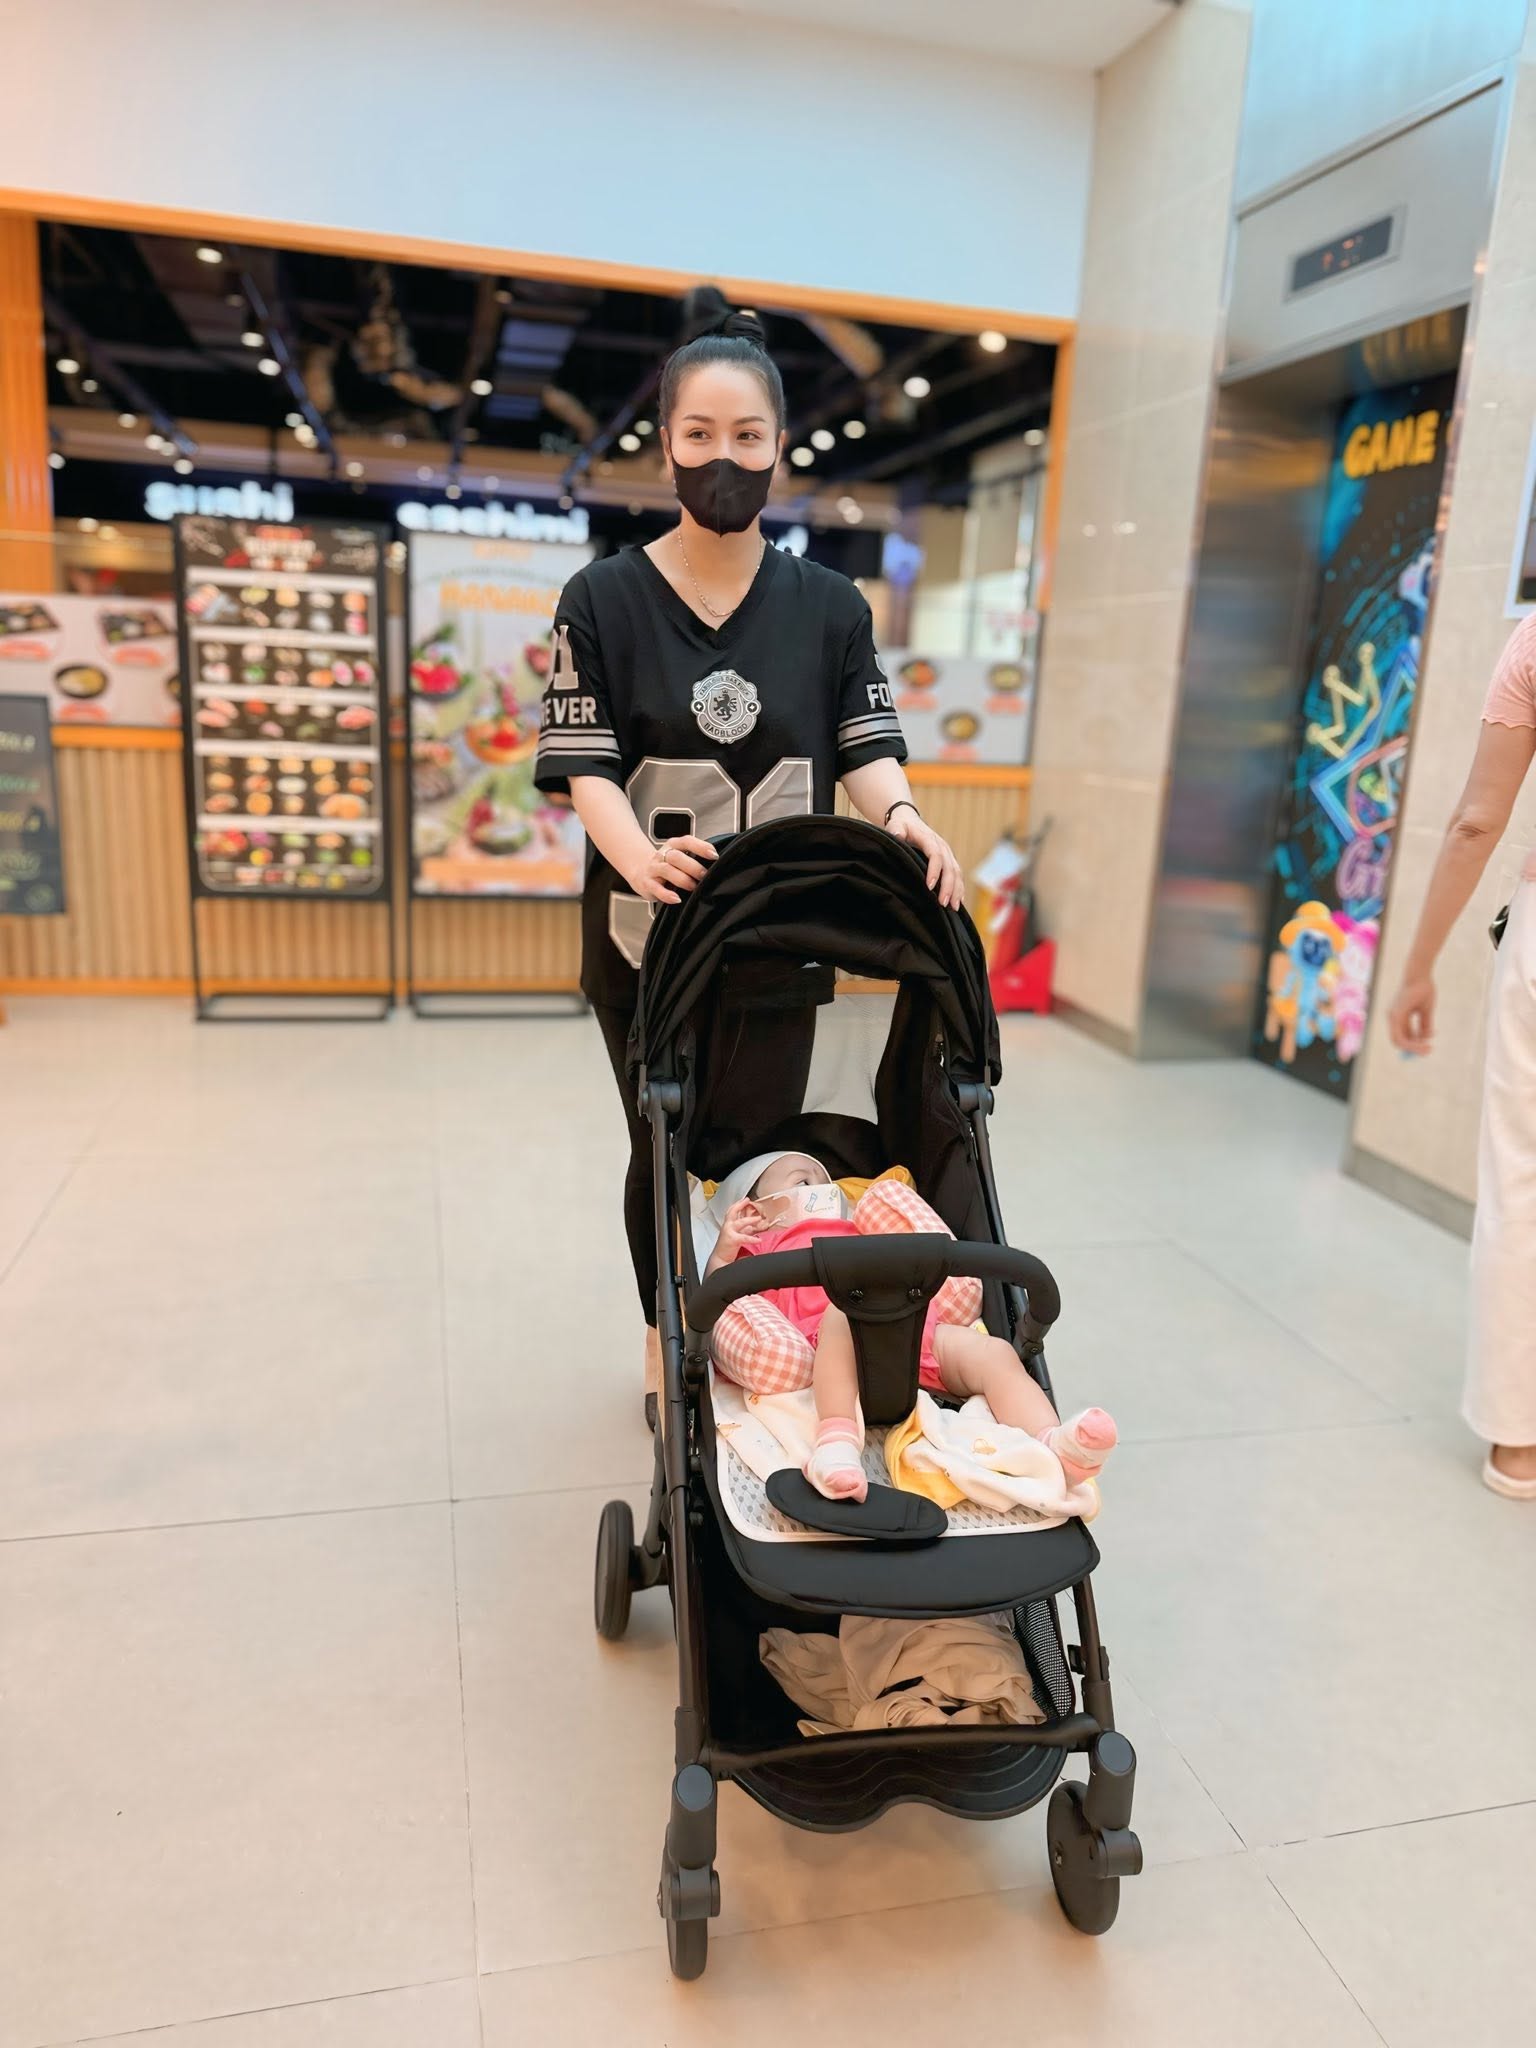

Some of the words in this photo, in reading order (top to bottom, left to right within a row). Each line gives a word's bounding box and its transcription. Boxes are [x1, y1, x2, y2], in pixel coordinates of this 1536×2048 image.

[1343, 409, 1439, 478] GAME
[866, 682, 894, 710] FO
[541, 696, 597, 726] EVER
[703, 722, 748, 737] BADBLOOD
